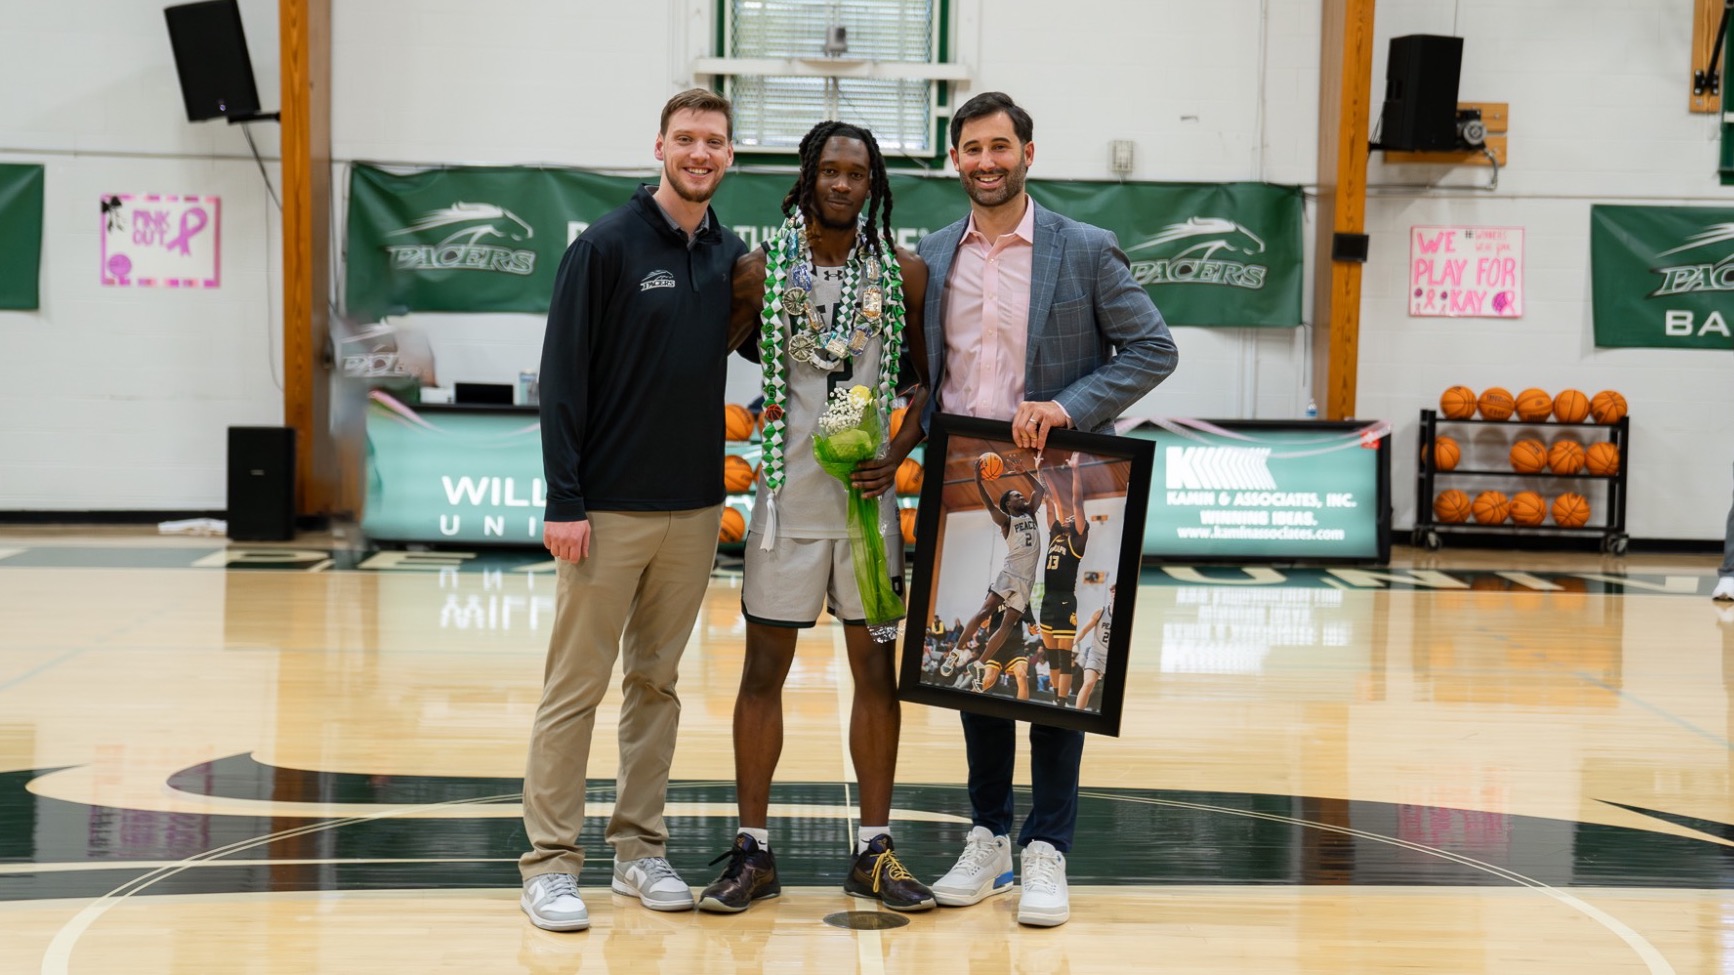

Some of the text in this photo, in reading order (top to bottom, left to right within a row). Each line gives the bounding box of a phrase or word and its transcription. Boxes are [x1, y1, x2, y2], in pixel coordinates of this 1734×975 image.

[132, 229, 167, 246] OUT
[1417, 231, 1457, 254] WE
[388, 244, 536, 275] PACERS
[1130, 258, 1267, 289] PACERS
[1414, 257, 1516, 287] PLAY FOR
[1651, 263, 1734, 297] PAC
[640, 280, 675, 291] PACERS
[1450, 289, 1487, 313] KAY
[1166, 492, 1216, 506] KAMIN
[1218, 492, 1231, 506] &
[1326, 493, 1357, 508] INC.
[1200, 510, 1318, 526] WINNING IDEAS.
[1025, 532, 1032, 547] 2
[1046, 555, 1060, 570] 13
